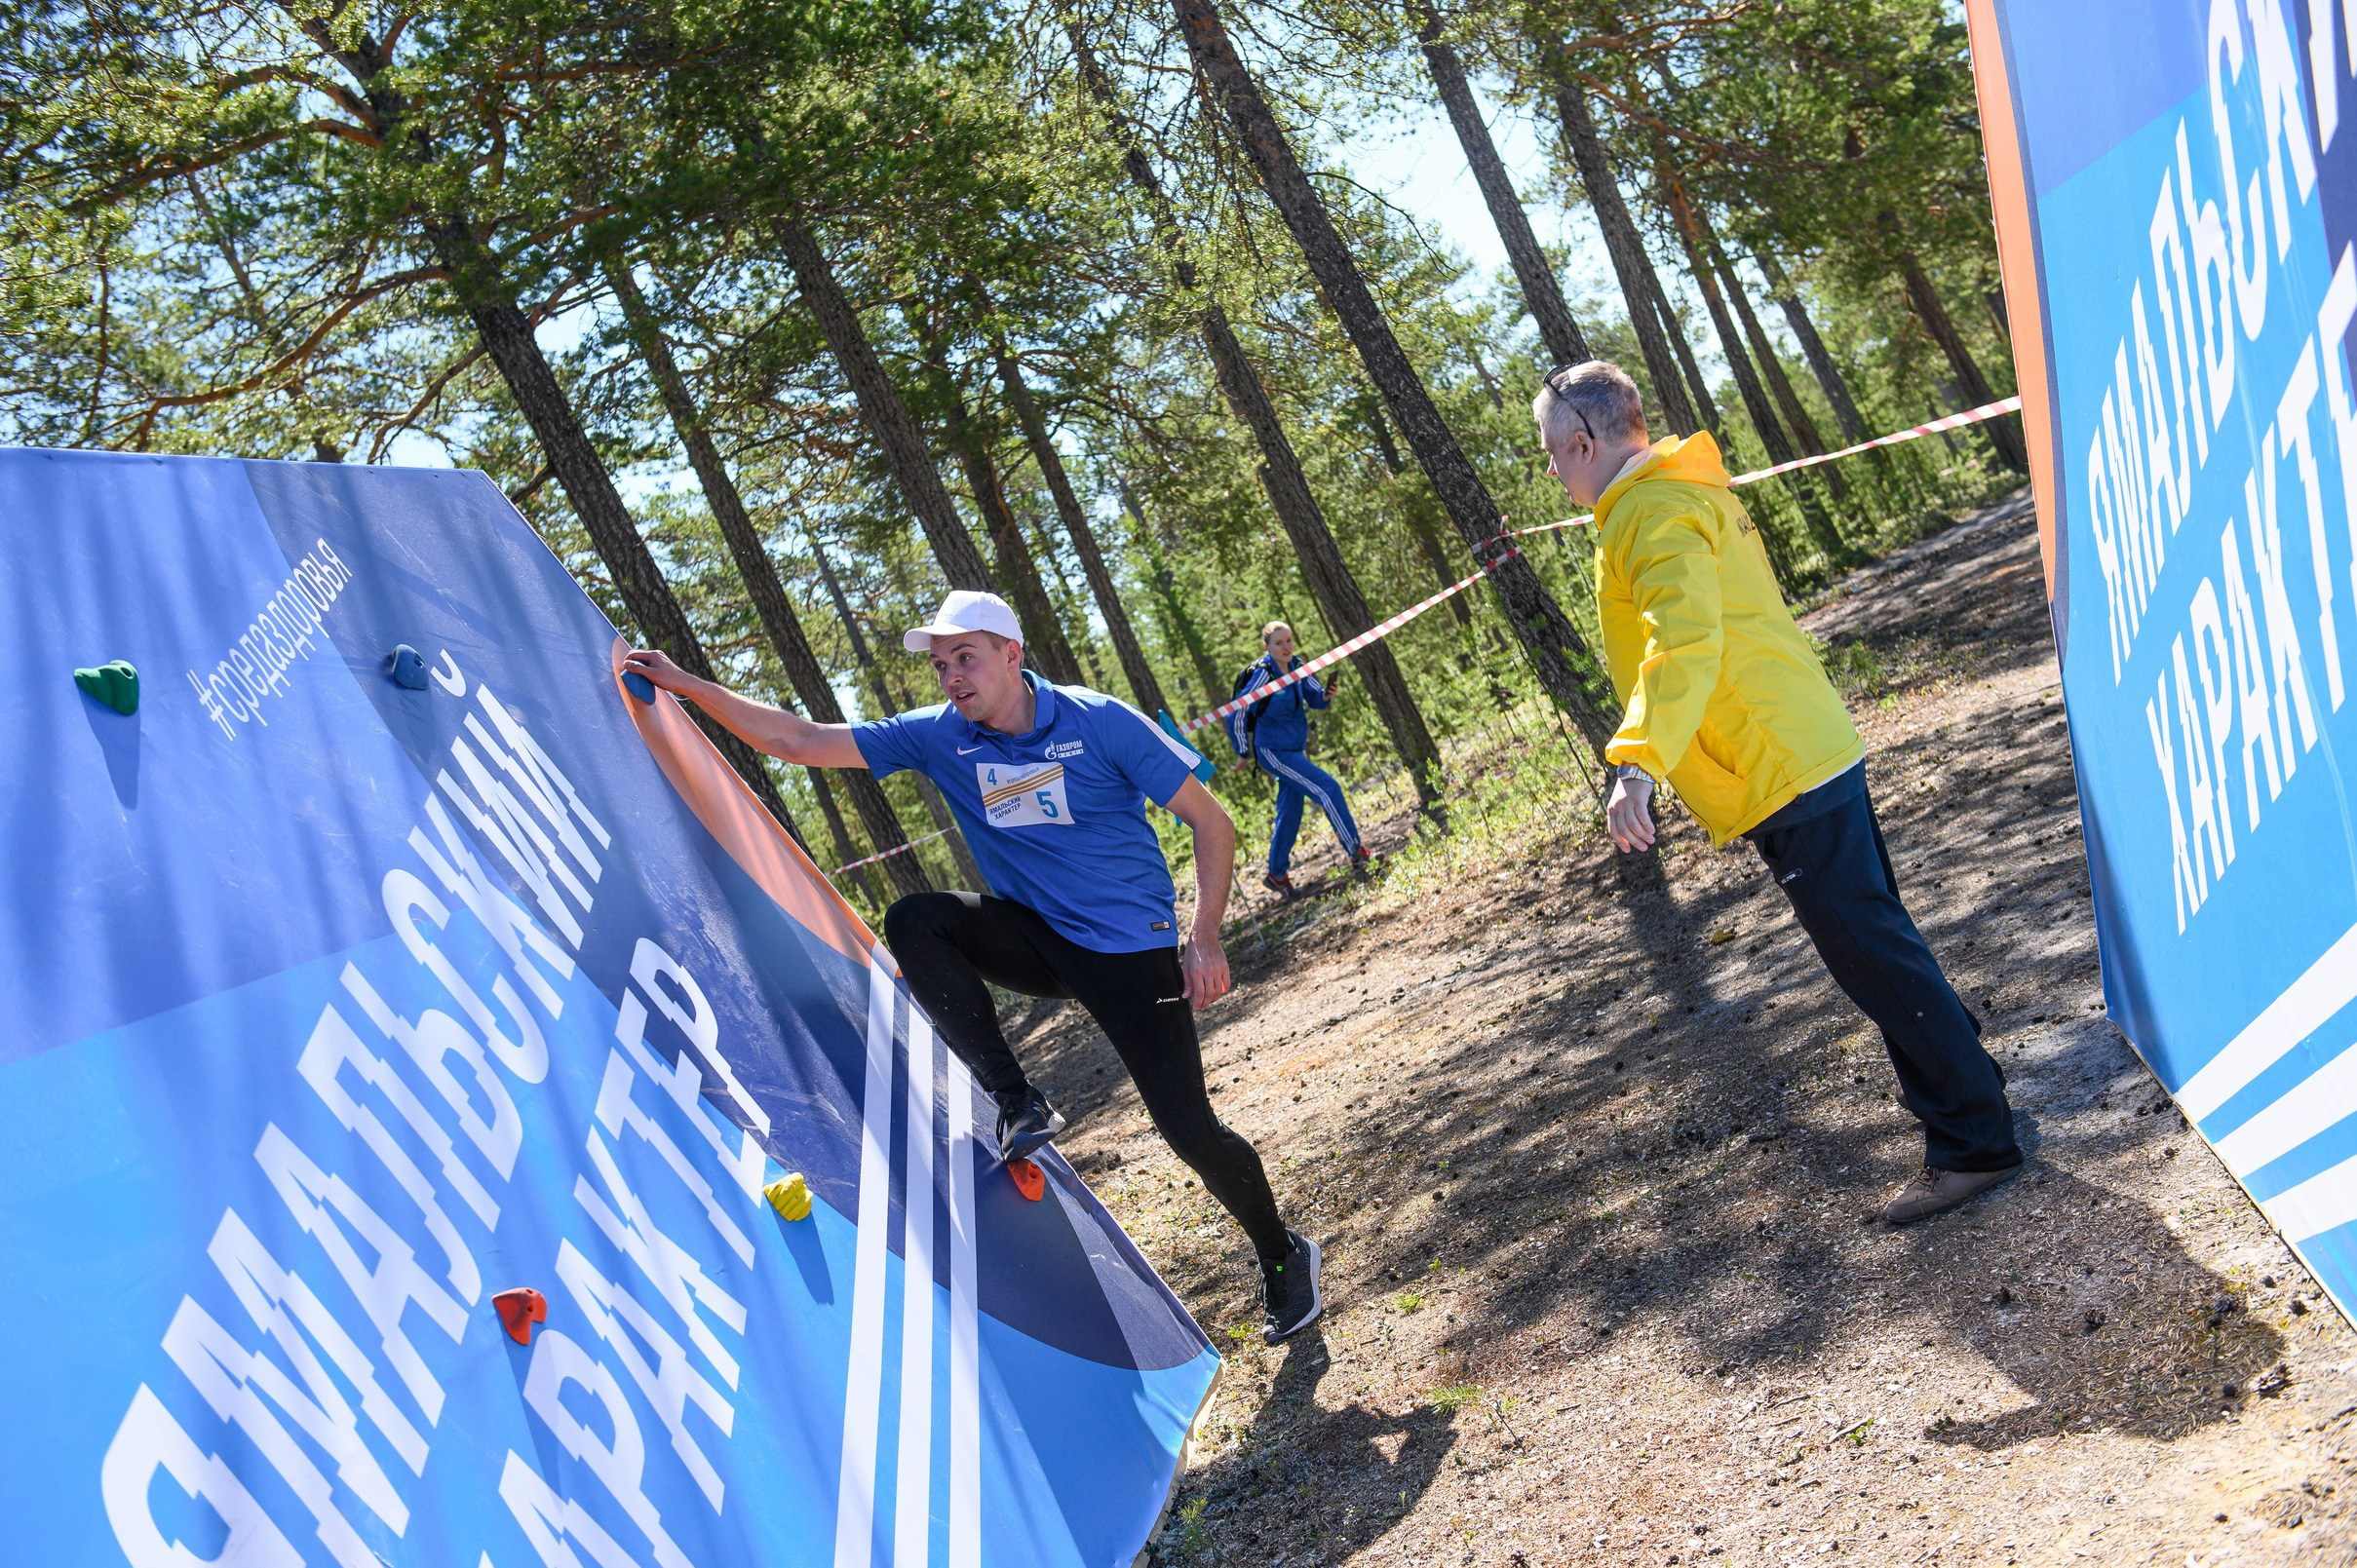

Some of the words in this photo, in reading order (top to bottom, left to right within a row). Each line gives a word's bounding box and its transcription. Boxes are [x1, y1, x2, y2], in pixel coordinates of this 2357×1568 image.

[186, 537, 353, 742] #средаздоровья
[1056, 739, 1083, 753] ГАЗПРОМ
[987, 768, 997, 785] 4
[988, 795, 1022, 816] ЯМАЛЬСКИЙ
[994, 802, 1022, 822] ХАРАКТЕР
[1036, 791, 1059, 819] 5
[101, 648, 611, 1568] ЯМАЛЬСКИЙ
[475, 937, 771, 1568] РАКТЕР
